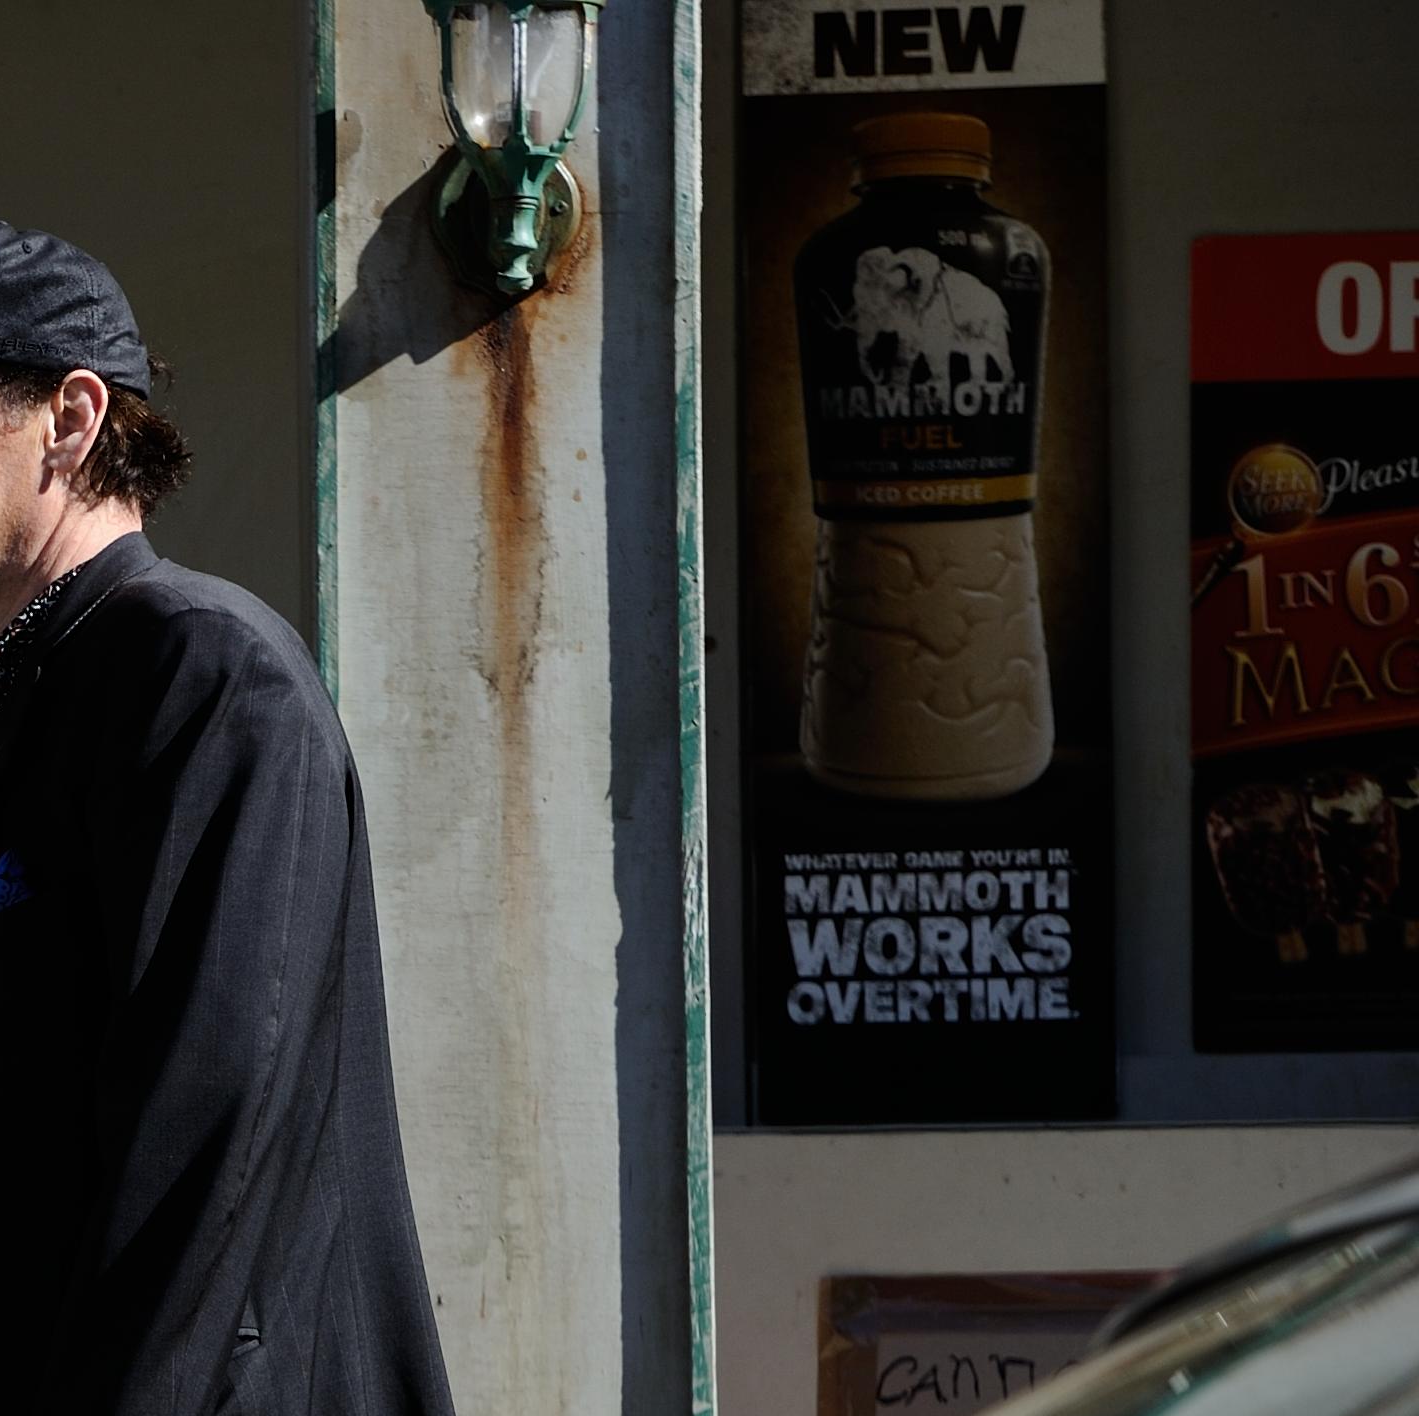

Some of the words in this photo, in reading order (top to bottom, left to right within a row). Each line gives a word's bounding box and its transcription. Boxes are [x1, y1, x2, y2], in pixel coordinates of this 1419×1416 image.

[813, 5, 1025, 78] NEW
[879, 423, 964, 450] FUEL
[855, 485, 900, 503] ICED
[905, 483, 985, 502] COFFEE
[1231, 552, 1285, 637] 1
[1278, 569, 1337, 609] IN
[1346, 542, 1409, 627] 6
[783, 852, 898, 871] WHATEVER
[904, 850, 964, 869] GAME
[970, 848, 1042, 867] YOU'RE
[784, 870, 1070, 914] MAMMOTH
[786, 913, 1073, 978] WORKS
